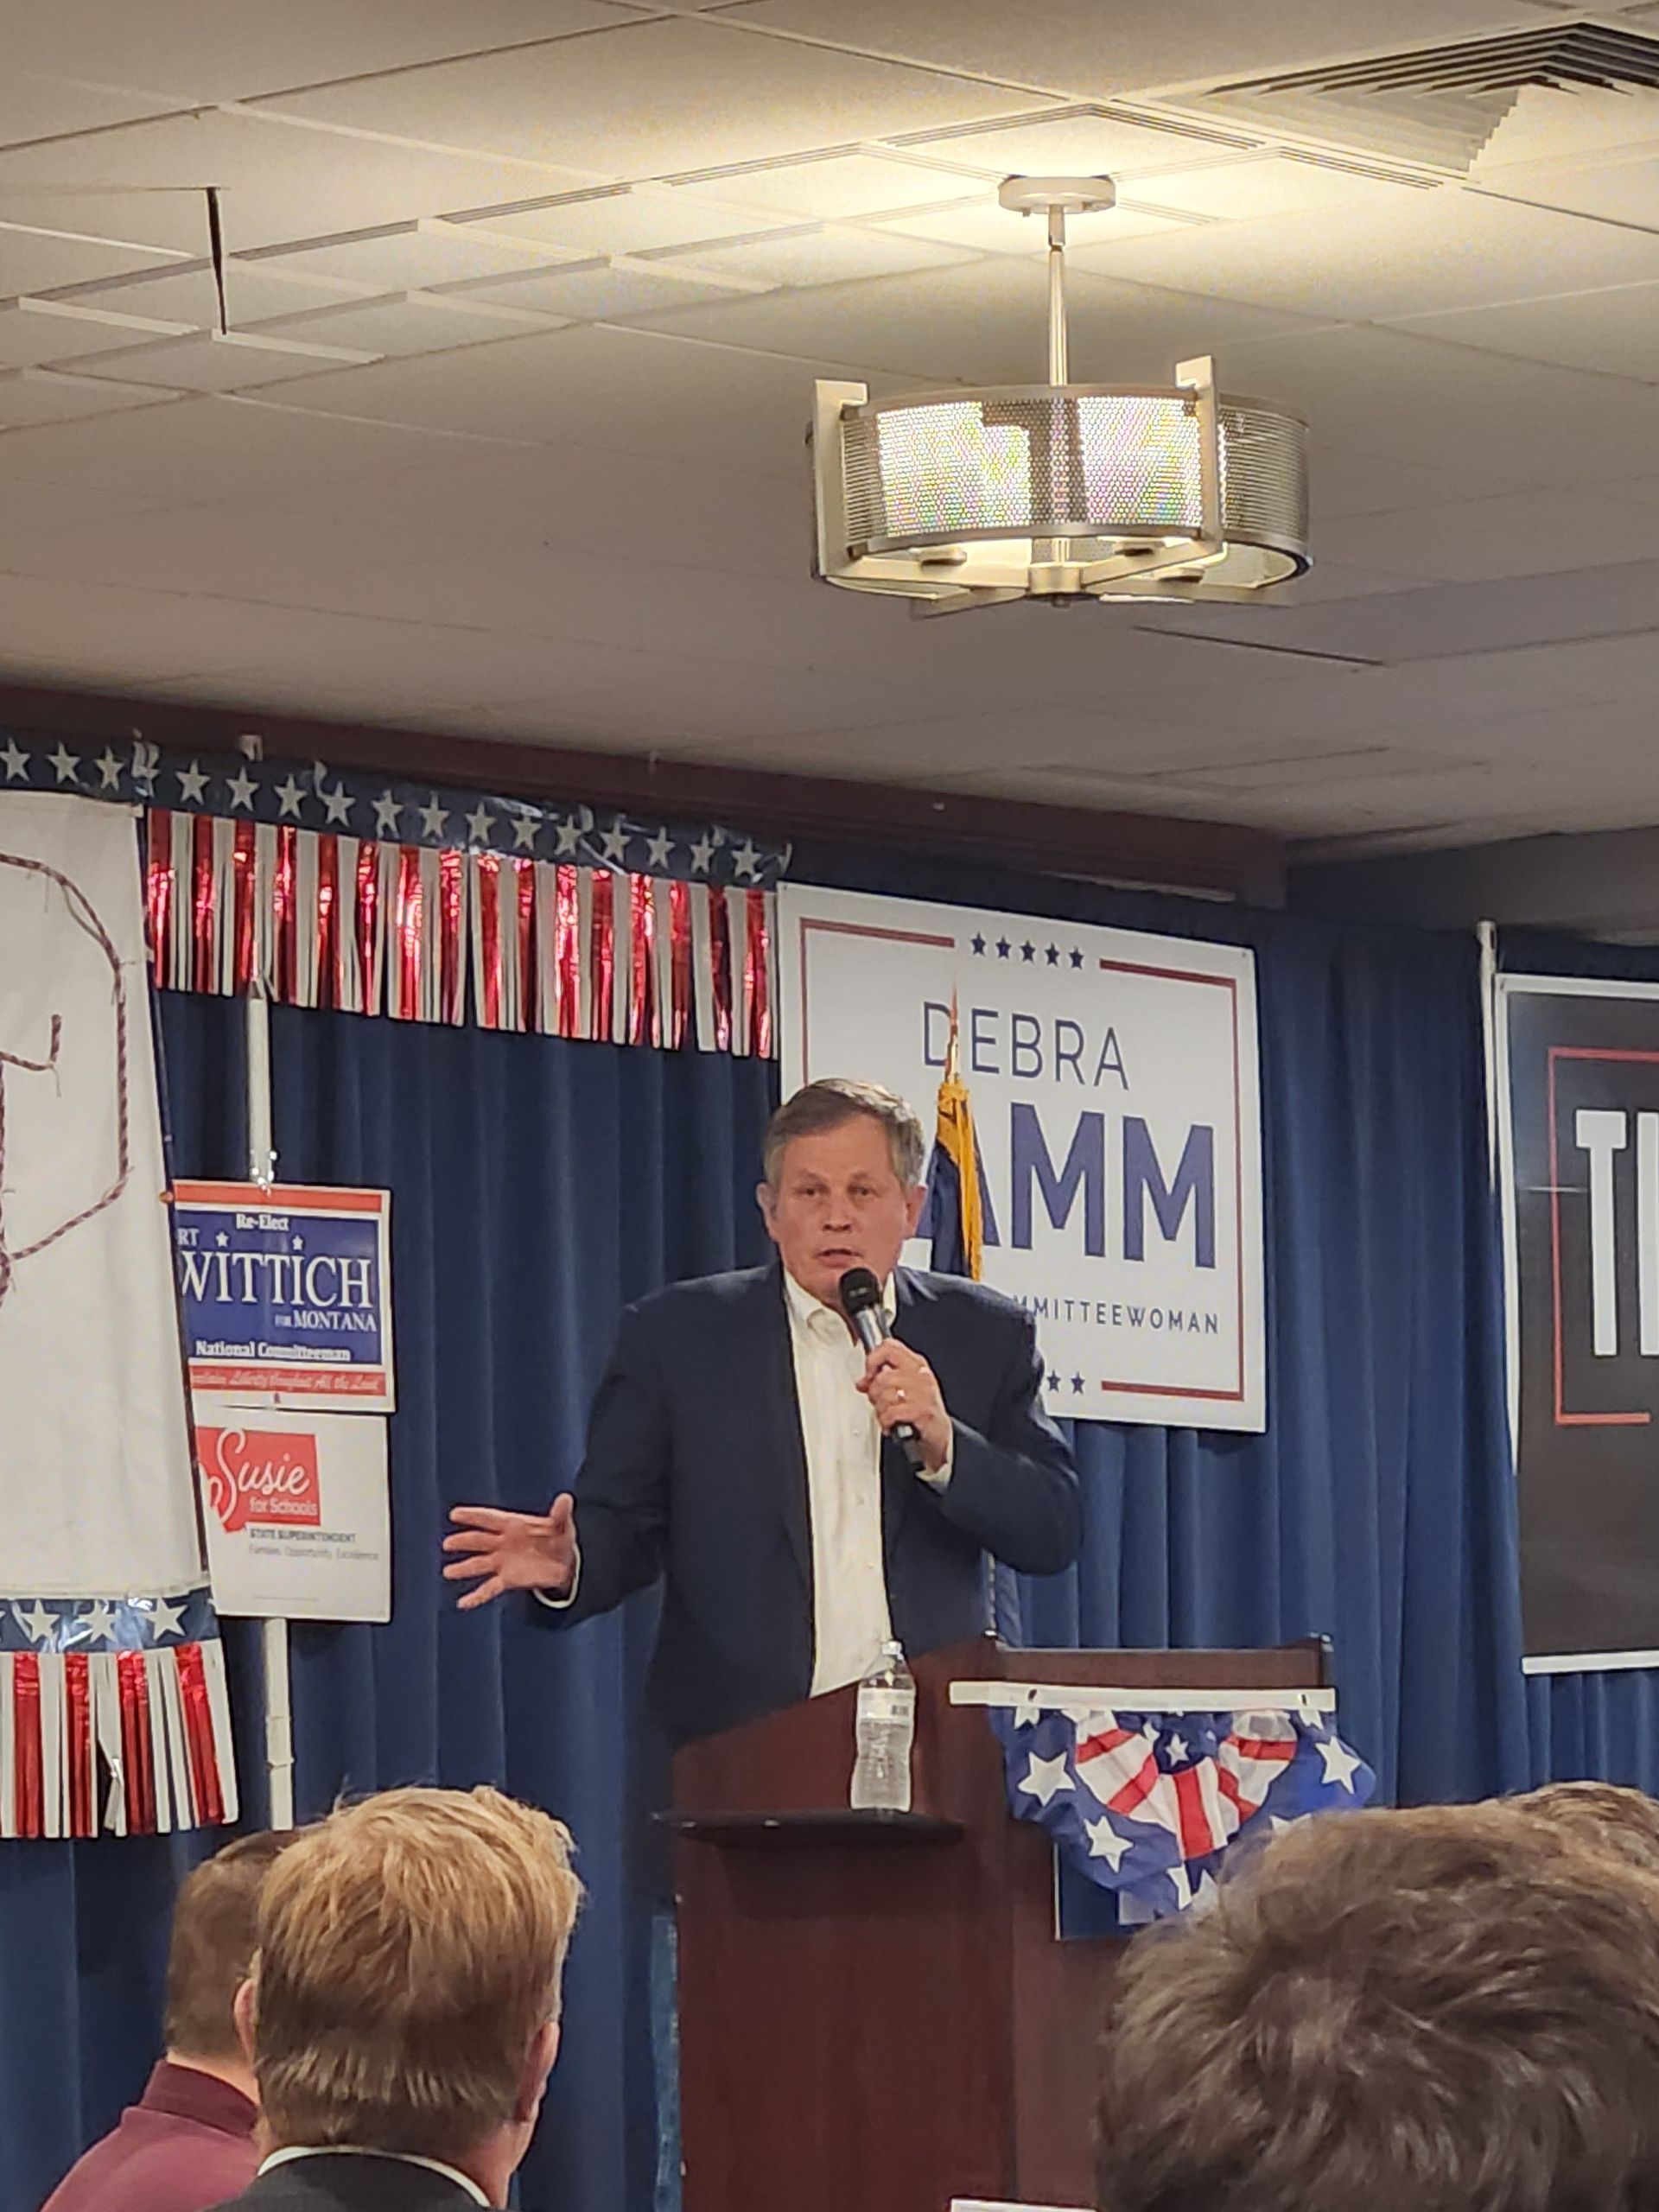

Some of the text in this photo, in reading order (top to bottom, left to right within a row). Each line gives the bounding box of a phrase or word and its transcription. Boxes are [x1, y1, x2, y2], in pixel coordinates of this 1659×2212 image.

[924, 1001, 1129, 1090] DEBRA
[180, 1250, 373, 1308] WITTICH
[292, 1310, 378, 1332] MONTANA
[195, 1340, 256, 1357] National
[209, 1427, 309, 1523] Susie
[270, 1497, 318, 1516] Schools
